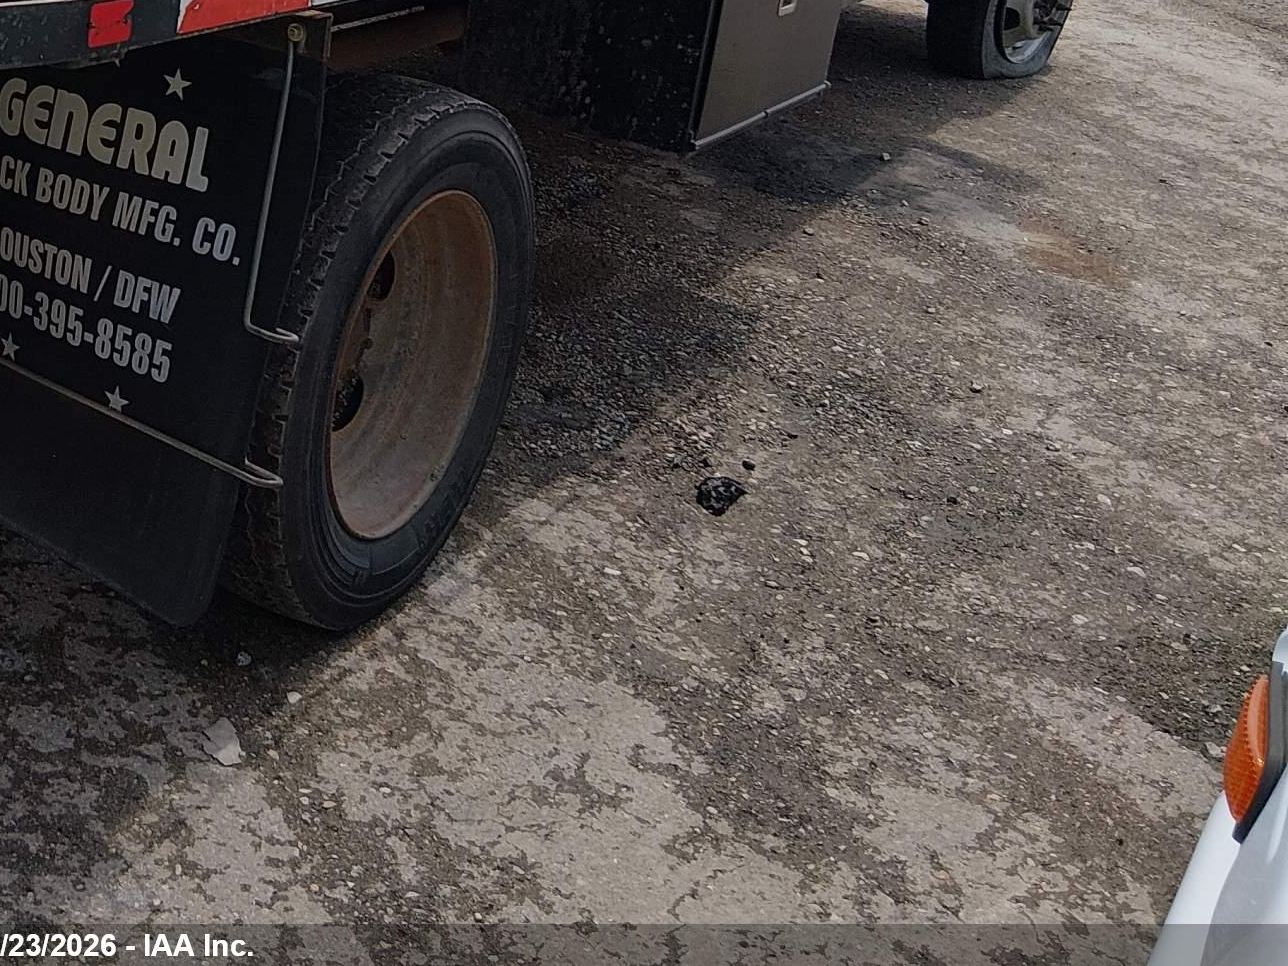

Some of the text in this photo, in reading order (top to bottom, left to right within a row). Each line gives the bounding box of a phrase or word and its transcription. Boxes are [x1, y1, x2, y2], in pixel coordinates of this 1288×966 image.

[35, 167, 110, 221] BODY
[112, 191, 181, 246] MFG.
[192, 217, 240, 266] CO.
[93, 265, 112, 302] /
[113, 269, 181, 324] DFW
